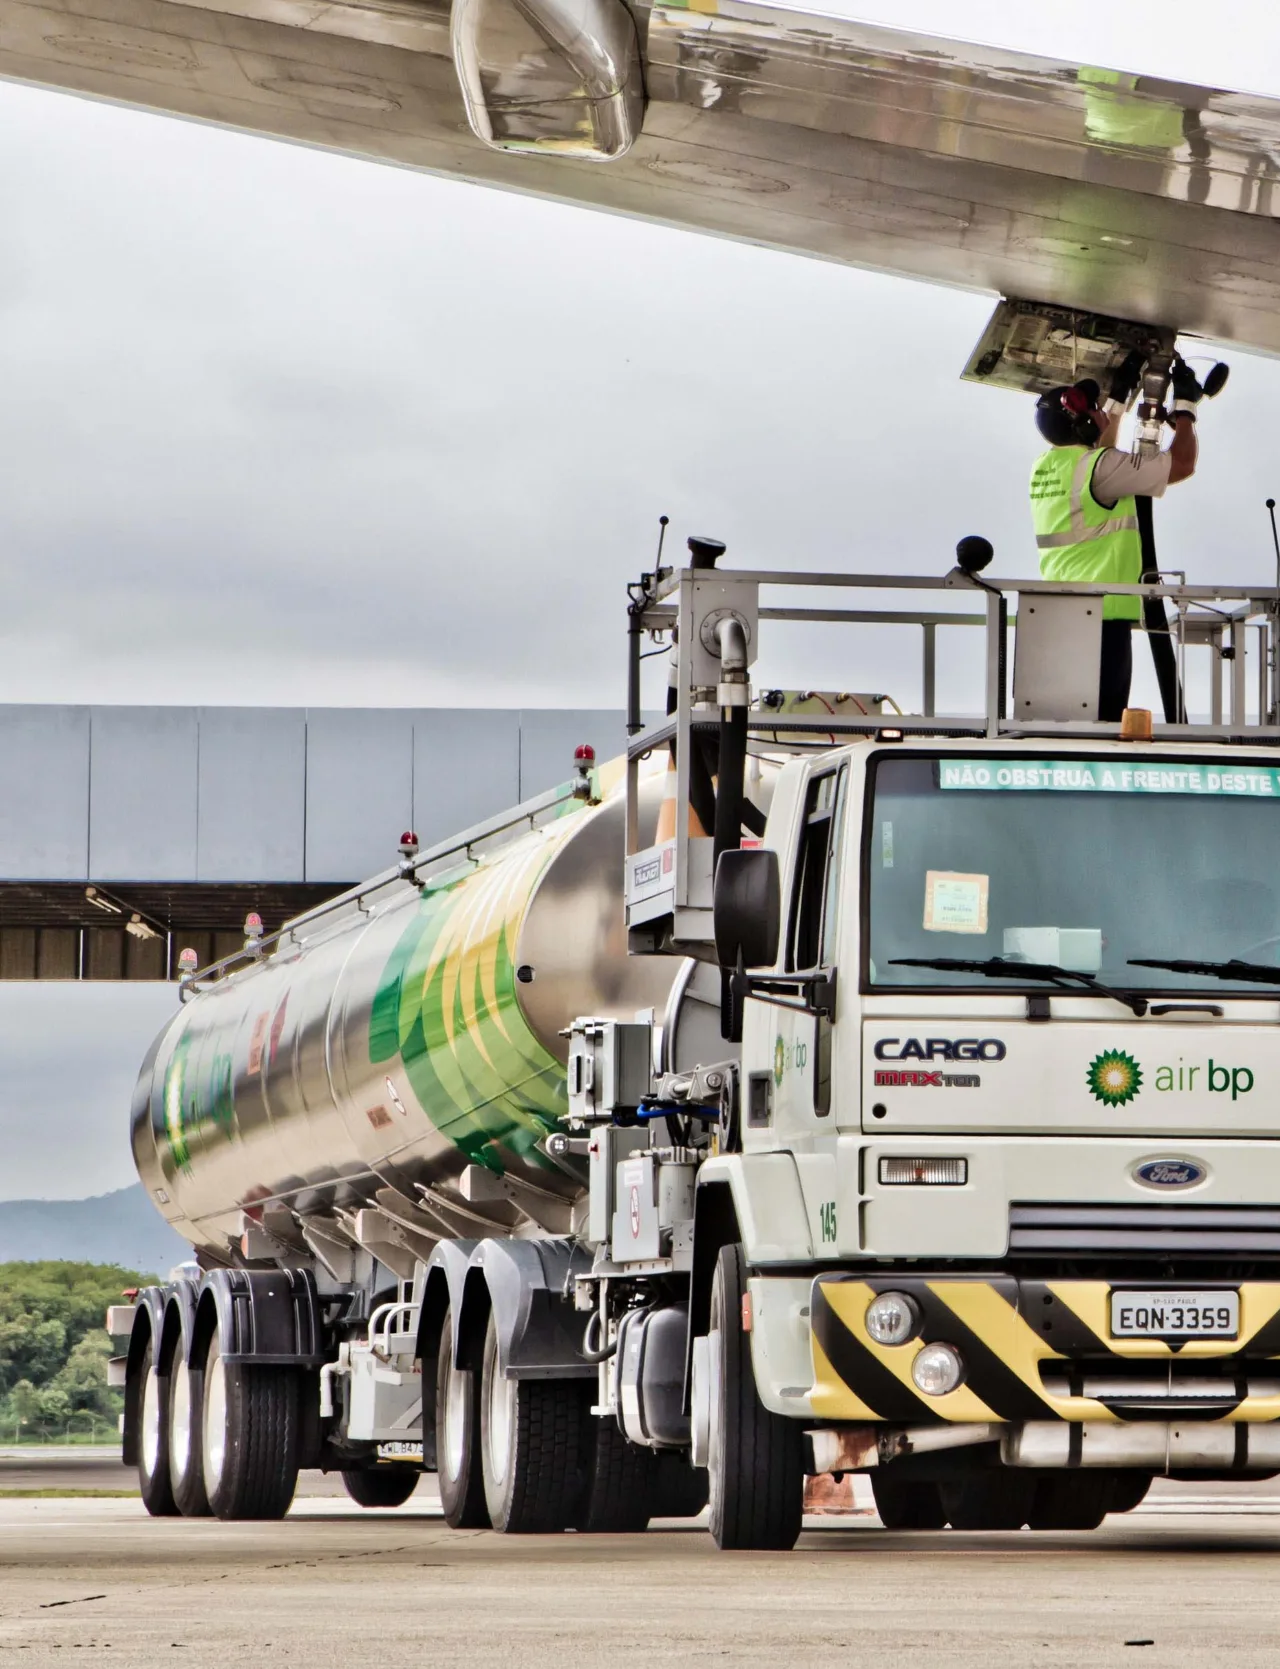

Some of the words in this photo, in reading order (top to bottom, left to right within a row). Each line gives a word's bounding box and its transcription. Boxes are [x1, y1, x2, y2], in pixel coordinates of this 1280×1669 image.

[945, 765, 990, 785] NÃO
[996, 768, 1095, 787] OBSTRUA
[1101, 770, 1116, 787] A
[1121, 770, 1202, 789] FRENTE
[1207, 773, 1273, 792] DESTE
[874, 1038, 1007, 1063] CARGO
[1155, 1057, 1201, 1091] air
[1208, 1058, 1254, 1101] bp
[1149, 1164, 1190, 1182] Ford
[819, 1201, 837, 1243] 145
